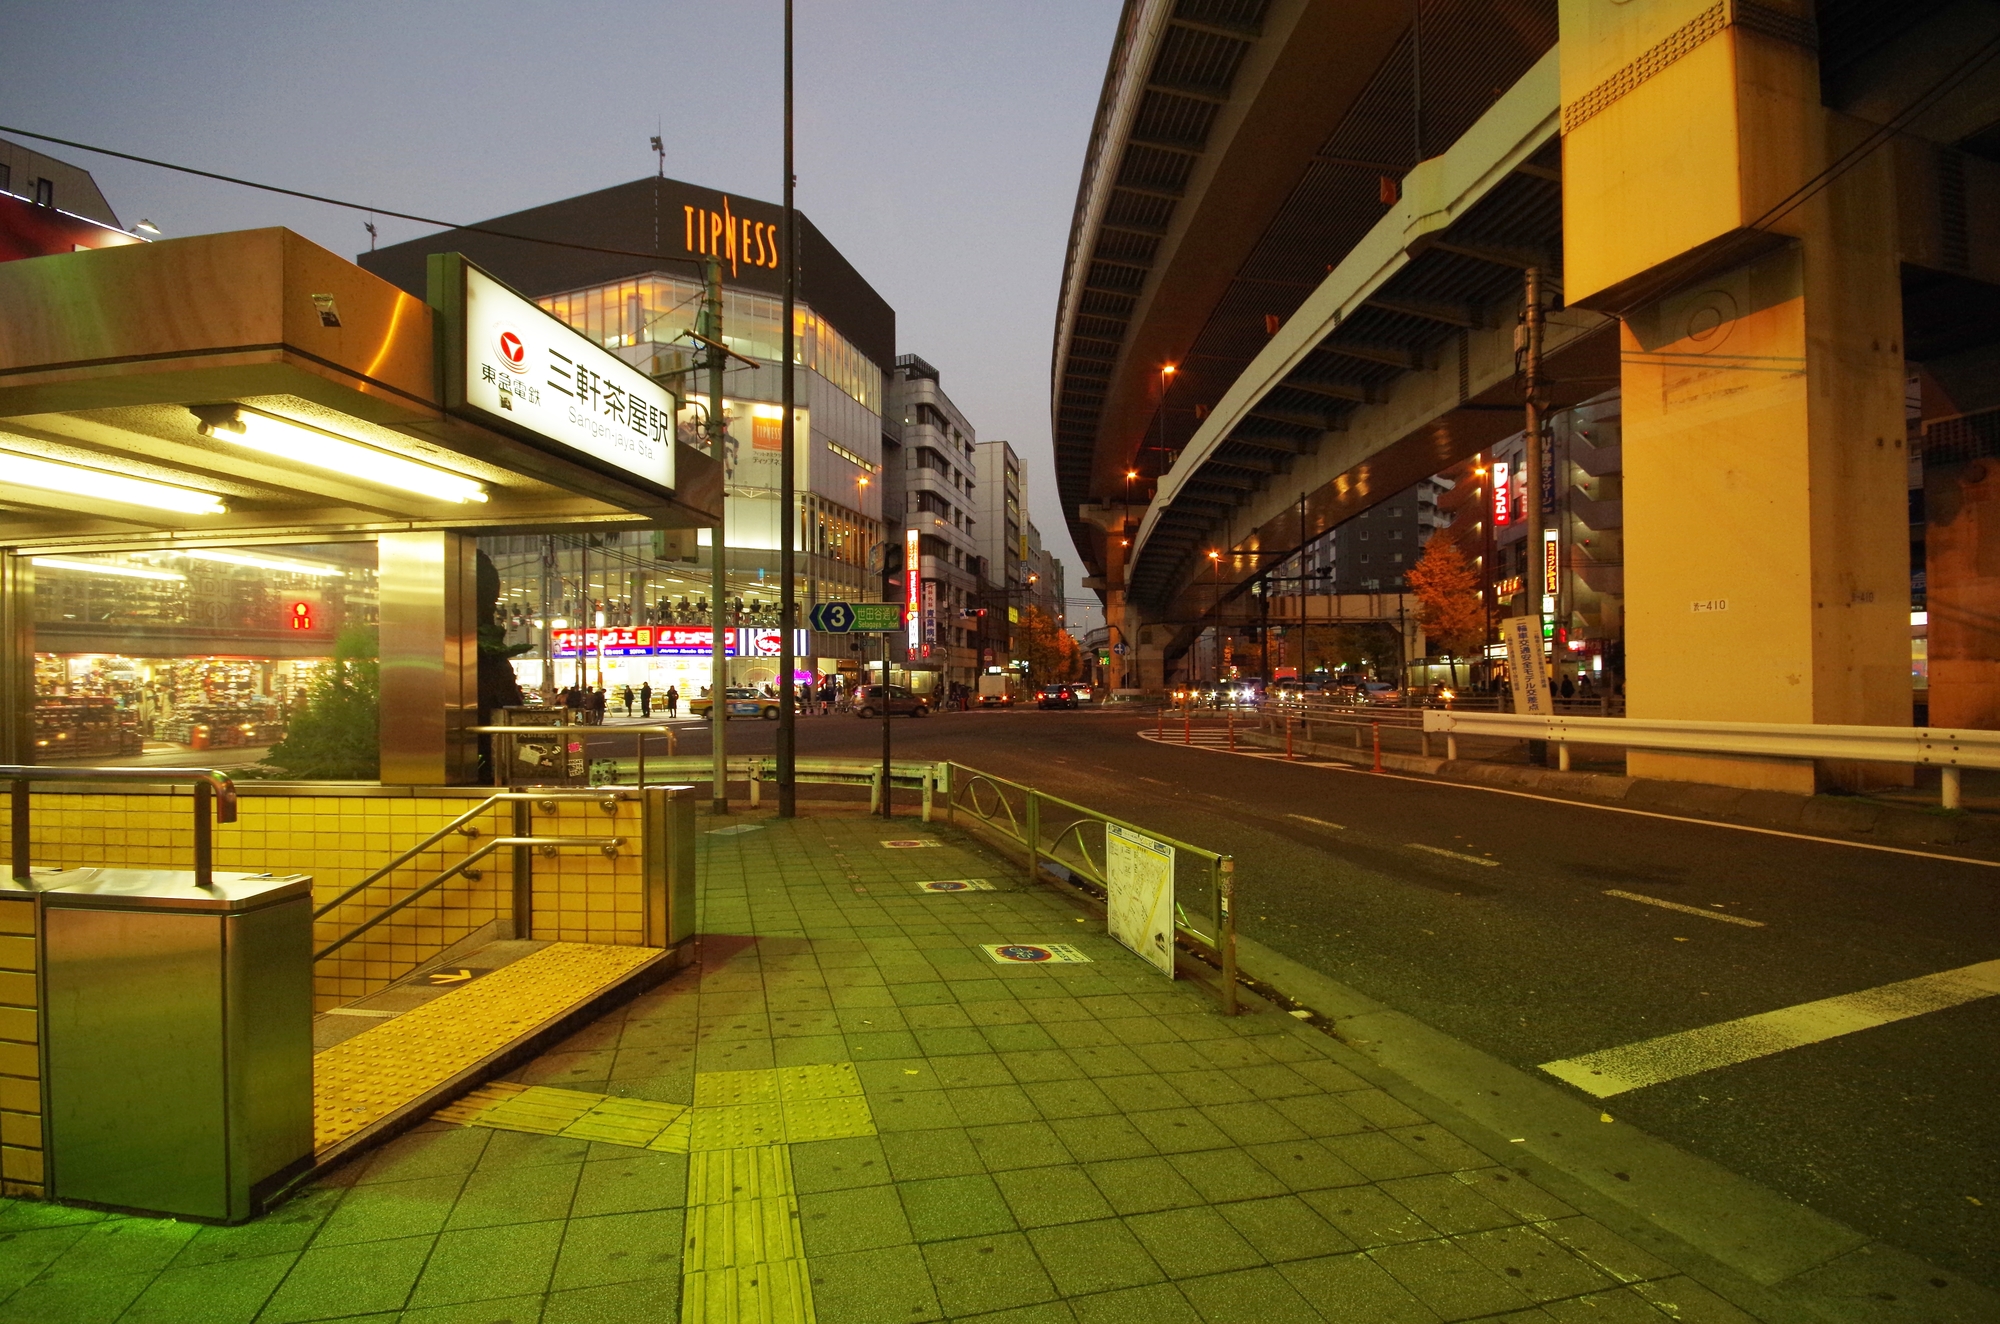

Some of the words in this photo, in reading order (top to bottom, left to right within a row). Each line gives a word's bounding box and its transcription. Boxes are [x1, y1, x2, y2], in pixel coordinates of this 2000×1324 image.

[684, 195, 777, 279] TIPNESS
[481, 362, 541, 407] 東急電鉄
[547, 348, 669, 448] 三軒茶屋駅
[568, 406, 636, 452] Sangen-jaya
[637, 442, 656, 461] Sta.
[756, 422, 781, 442] TIPNESS
[753, 456, 781, 466] ティップネ
[830, 605, 845, 627] 3
[857, 607, 899, 620] 世田谷通り
[1516, 618, 1539, 711] 二輪車交通安全モデル交差点
